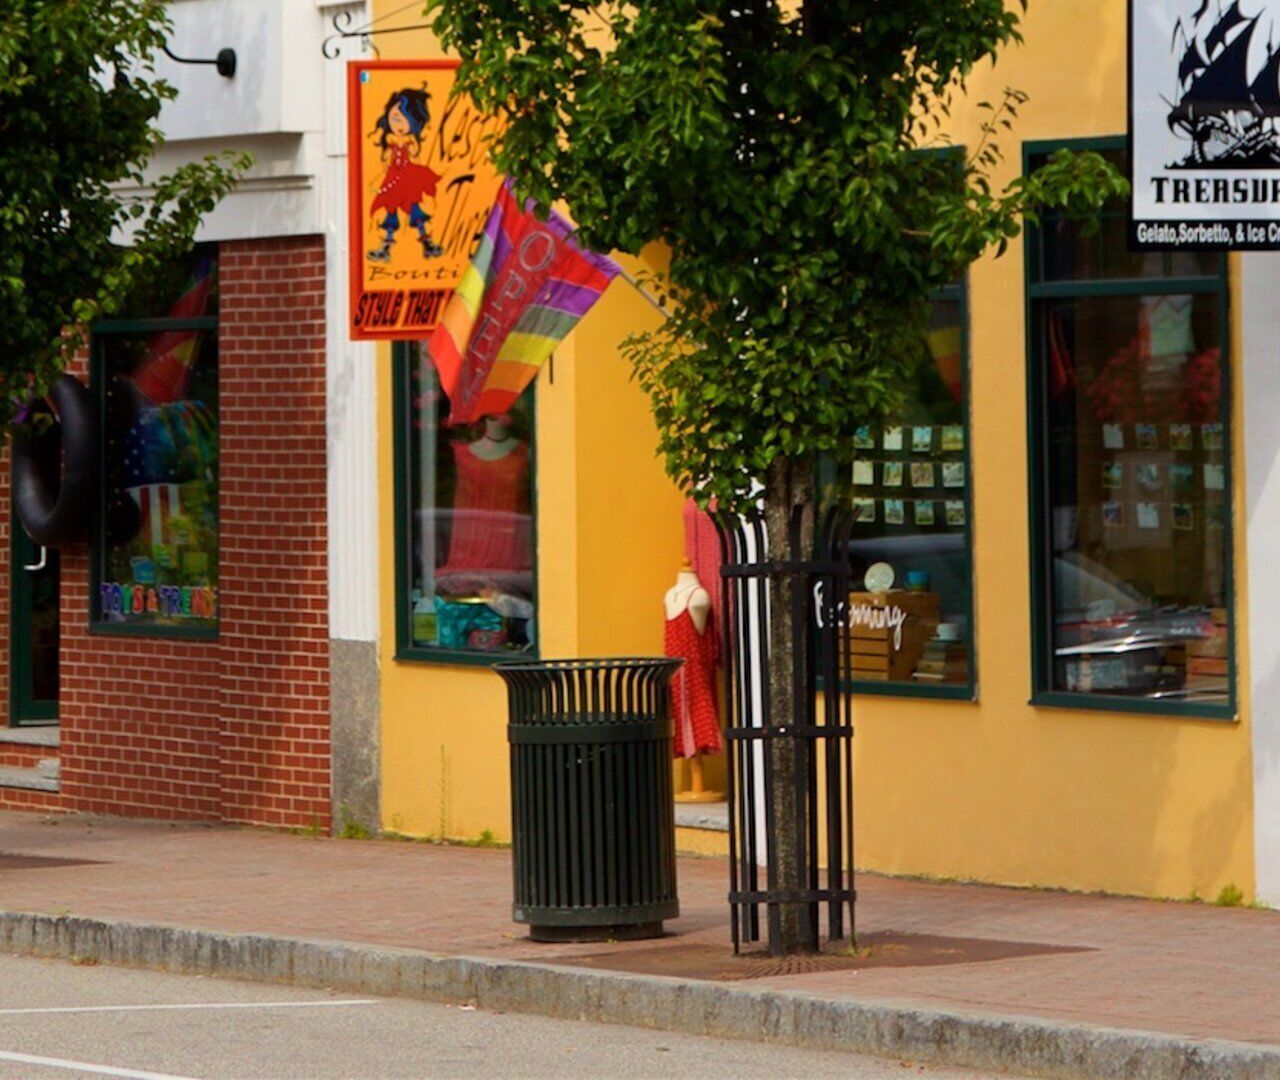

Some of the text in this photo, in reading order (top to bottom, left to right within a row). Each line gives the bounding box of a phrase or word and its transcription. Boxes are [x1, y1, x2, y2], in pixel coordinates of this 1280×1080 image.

[1235, 223, 1245, 242] &
[1247, 223, 1266, 242] Ice
[368, 264, 460, 281] Bouti
[100, 582, 144, 615] TOYS
